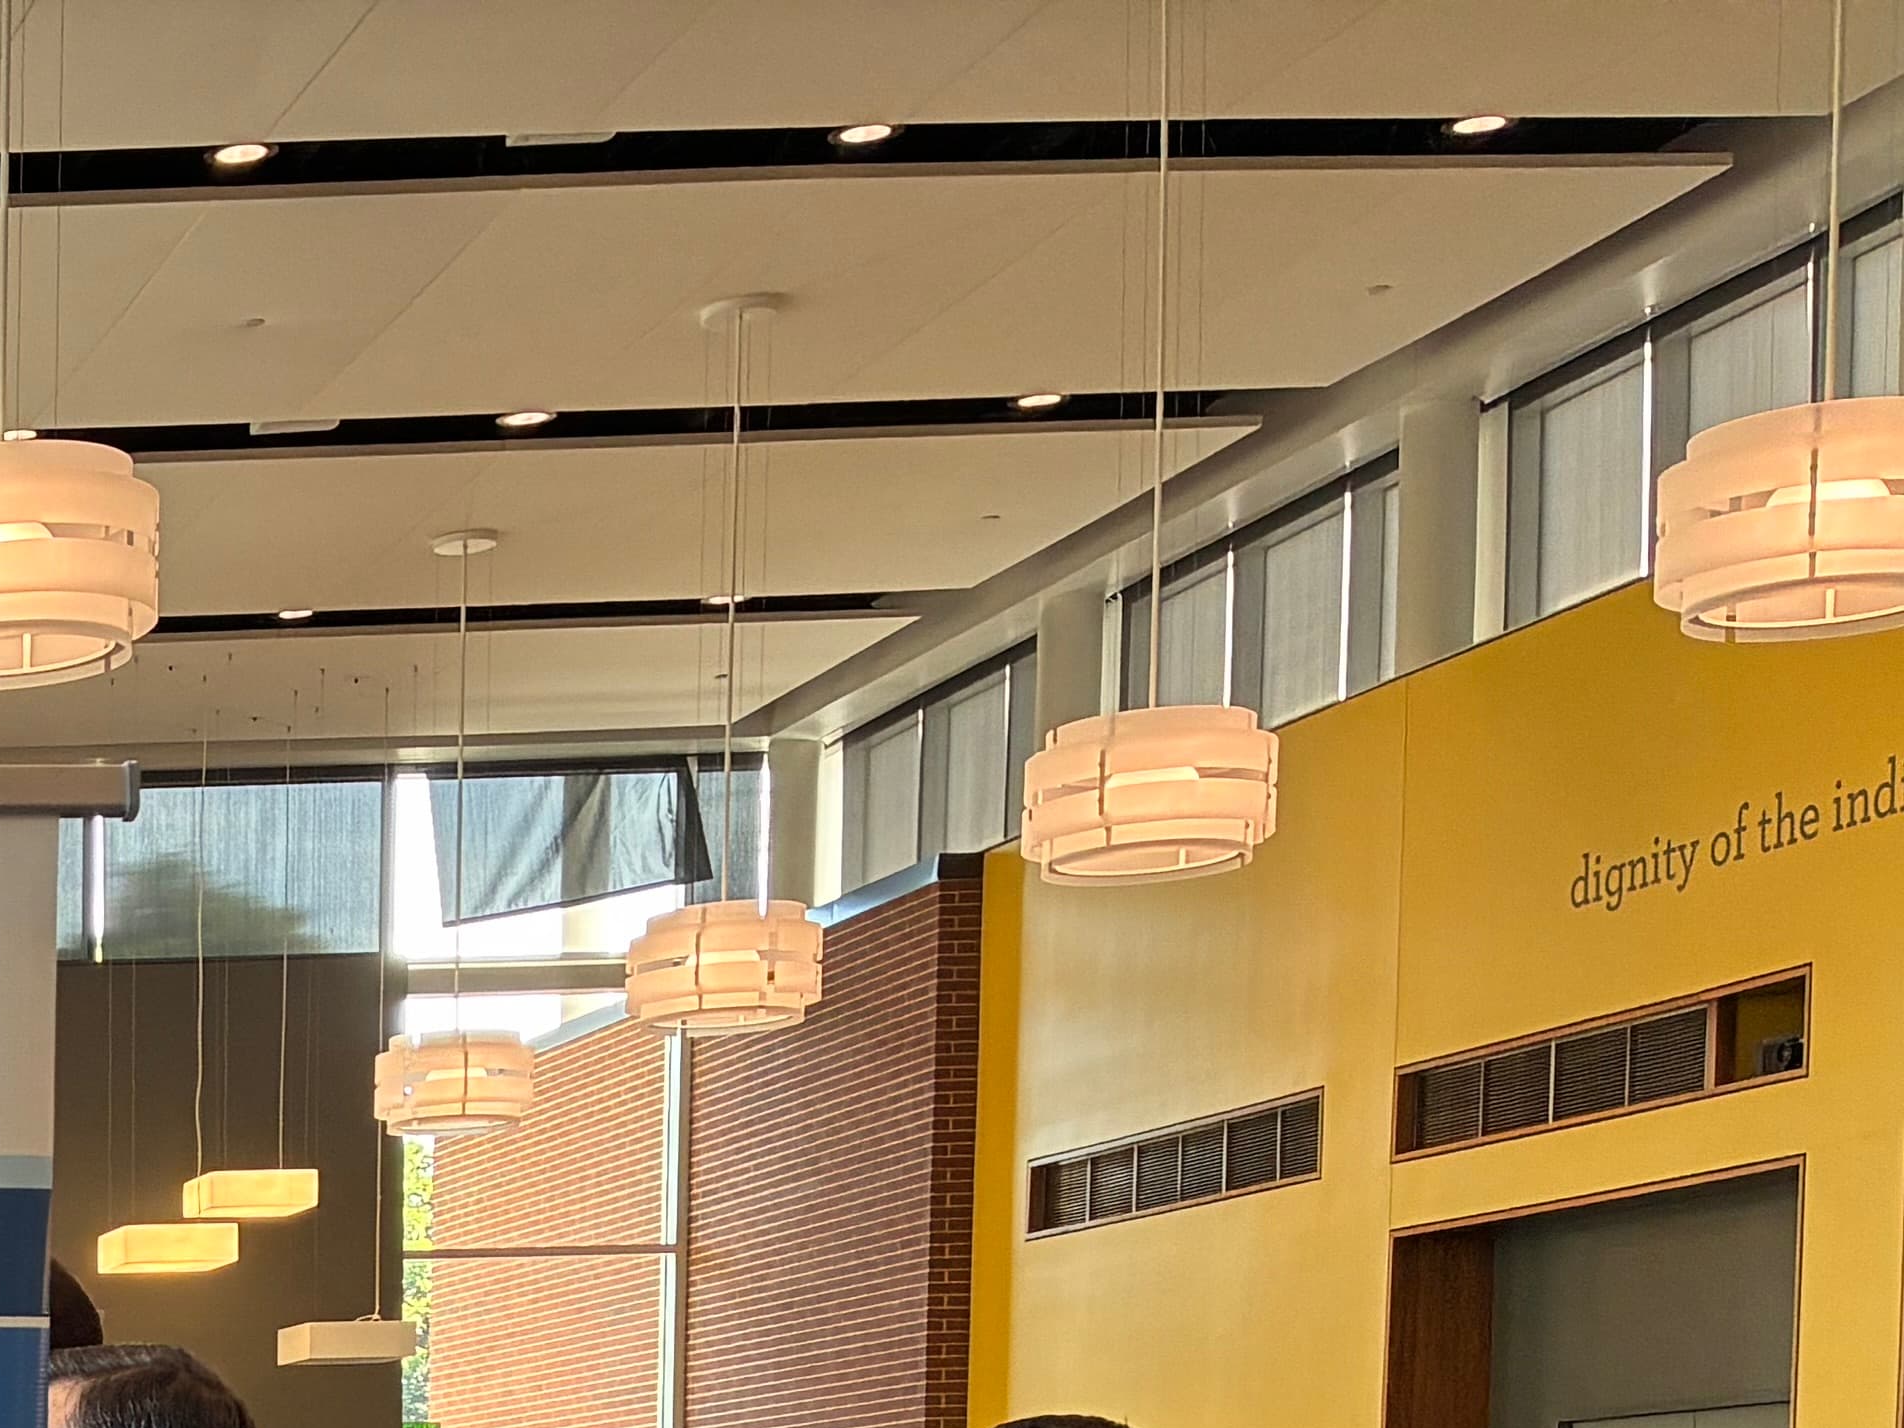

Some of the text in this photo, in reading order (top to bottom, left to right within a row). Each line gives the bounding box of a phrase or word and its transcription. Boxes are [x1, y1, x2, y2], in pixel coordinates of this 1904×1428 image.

[1570, 837, 1700, 912] dignity
[1710, 801, 1750, 867] of
[1757, 792, 1820, 853] the
